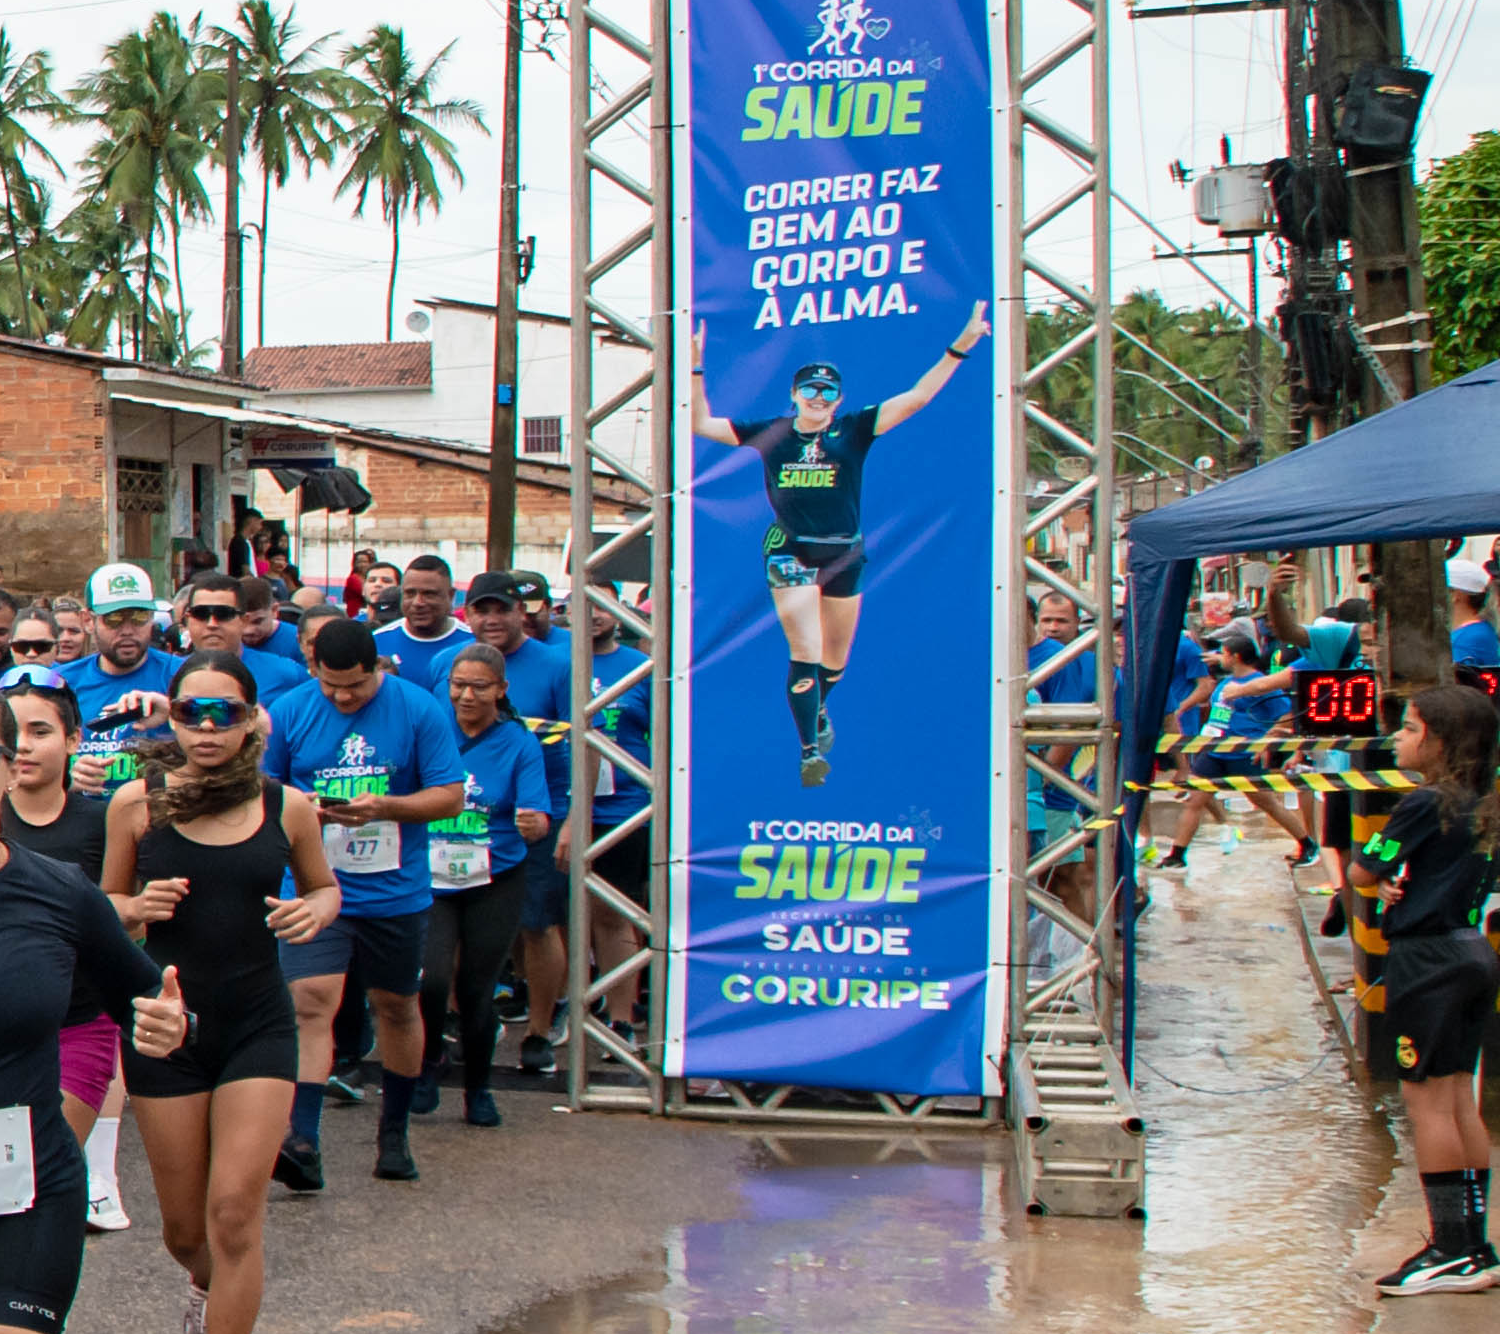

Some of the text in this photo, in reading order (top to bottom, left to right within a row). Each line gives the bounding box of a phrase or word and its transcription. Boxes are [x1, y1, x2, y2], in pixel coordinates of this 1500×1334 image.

[768, 57, 882, 82] CORRIDA
[886, 59, 915, 76] DA
[740, 79, 926, 142] SAÚDE
[743, 163, 942, 213] CORRER FAZ
[747, 202, 902, 251] BEM AO
[750, 240, 925, 291] CORPO E
[790, 283, 920, 326] ALMA.
[346, 839, 379, 856] 477
[764, 820, 881, 843] CORRIDA
[885, 826, 913, 842] DA
[734, 843, 927, 903] SAÚDE
[762, 920, 912, 956] SAÚDE
[720, 973, 951, 1011] CORURIPE
